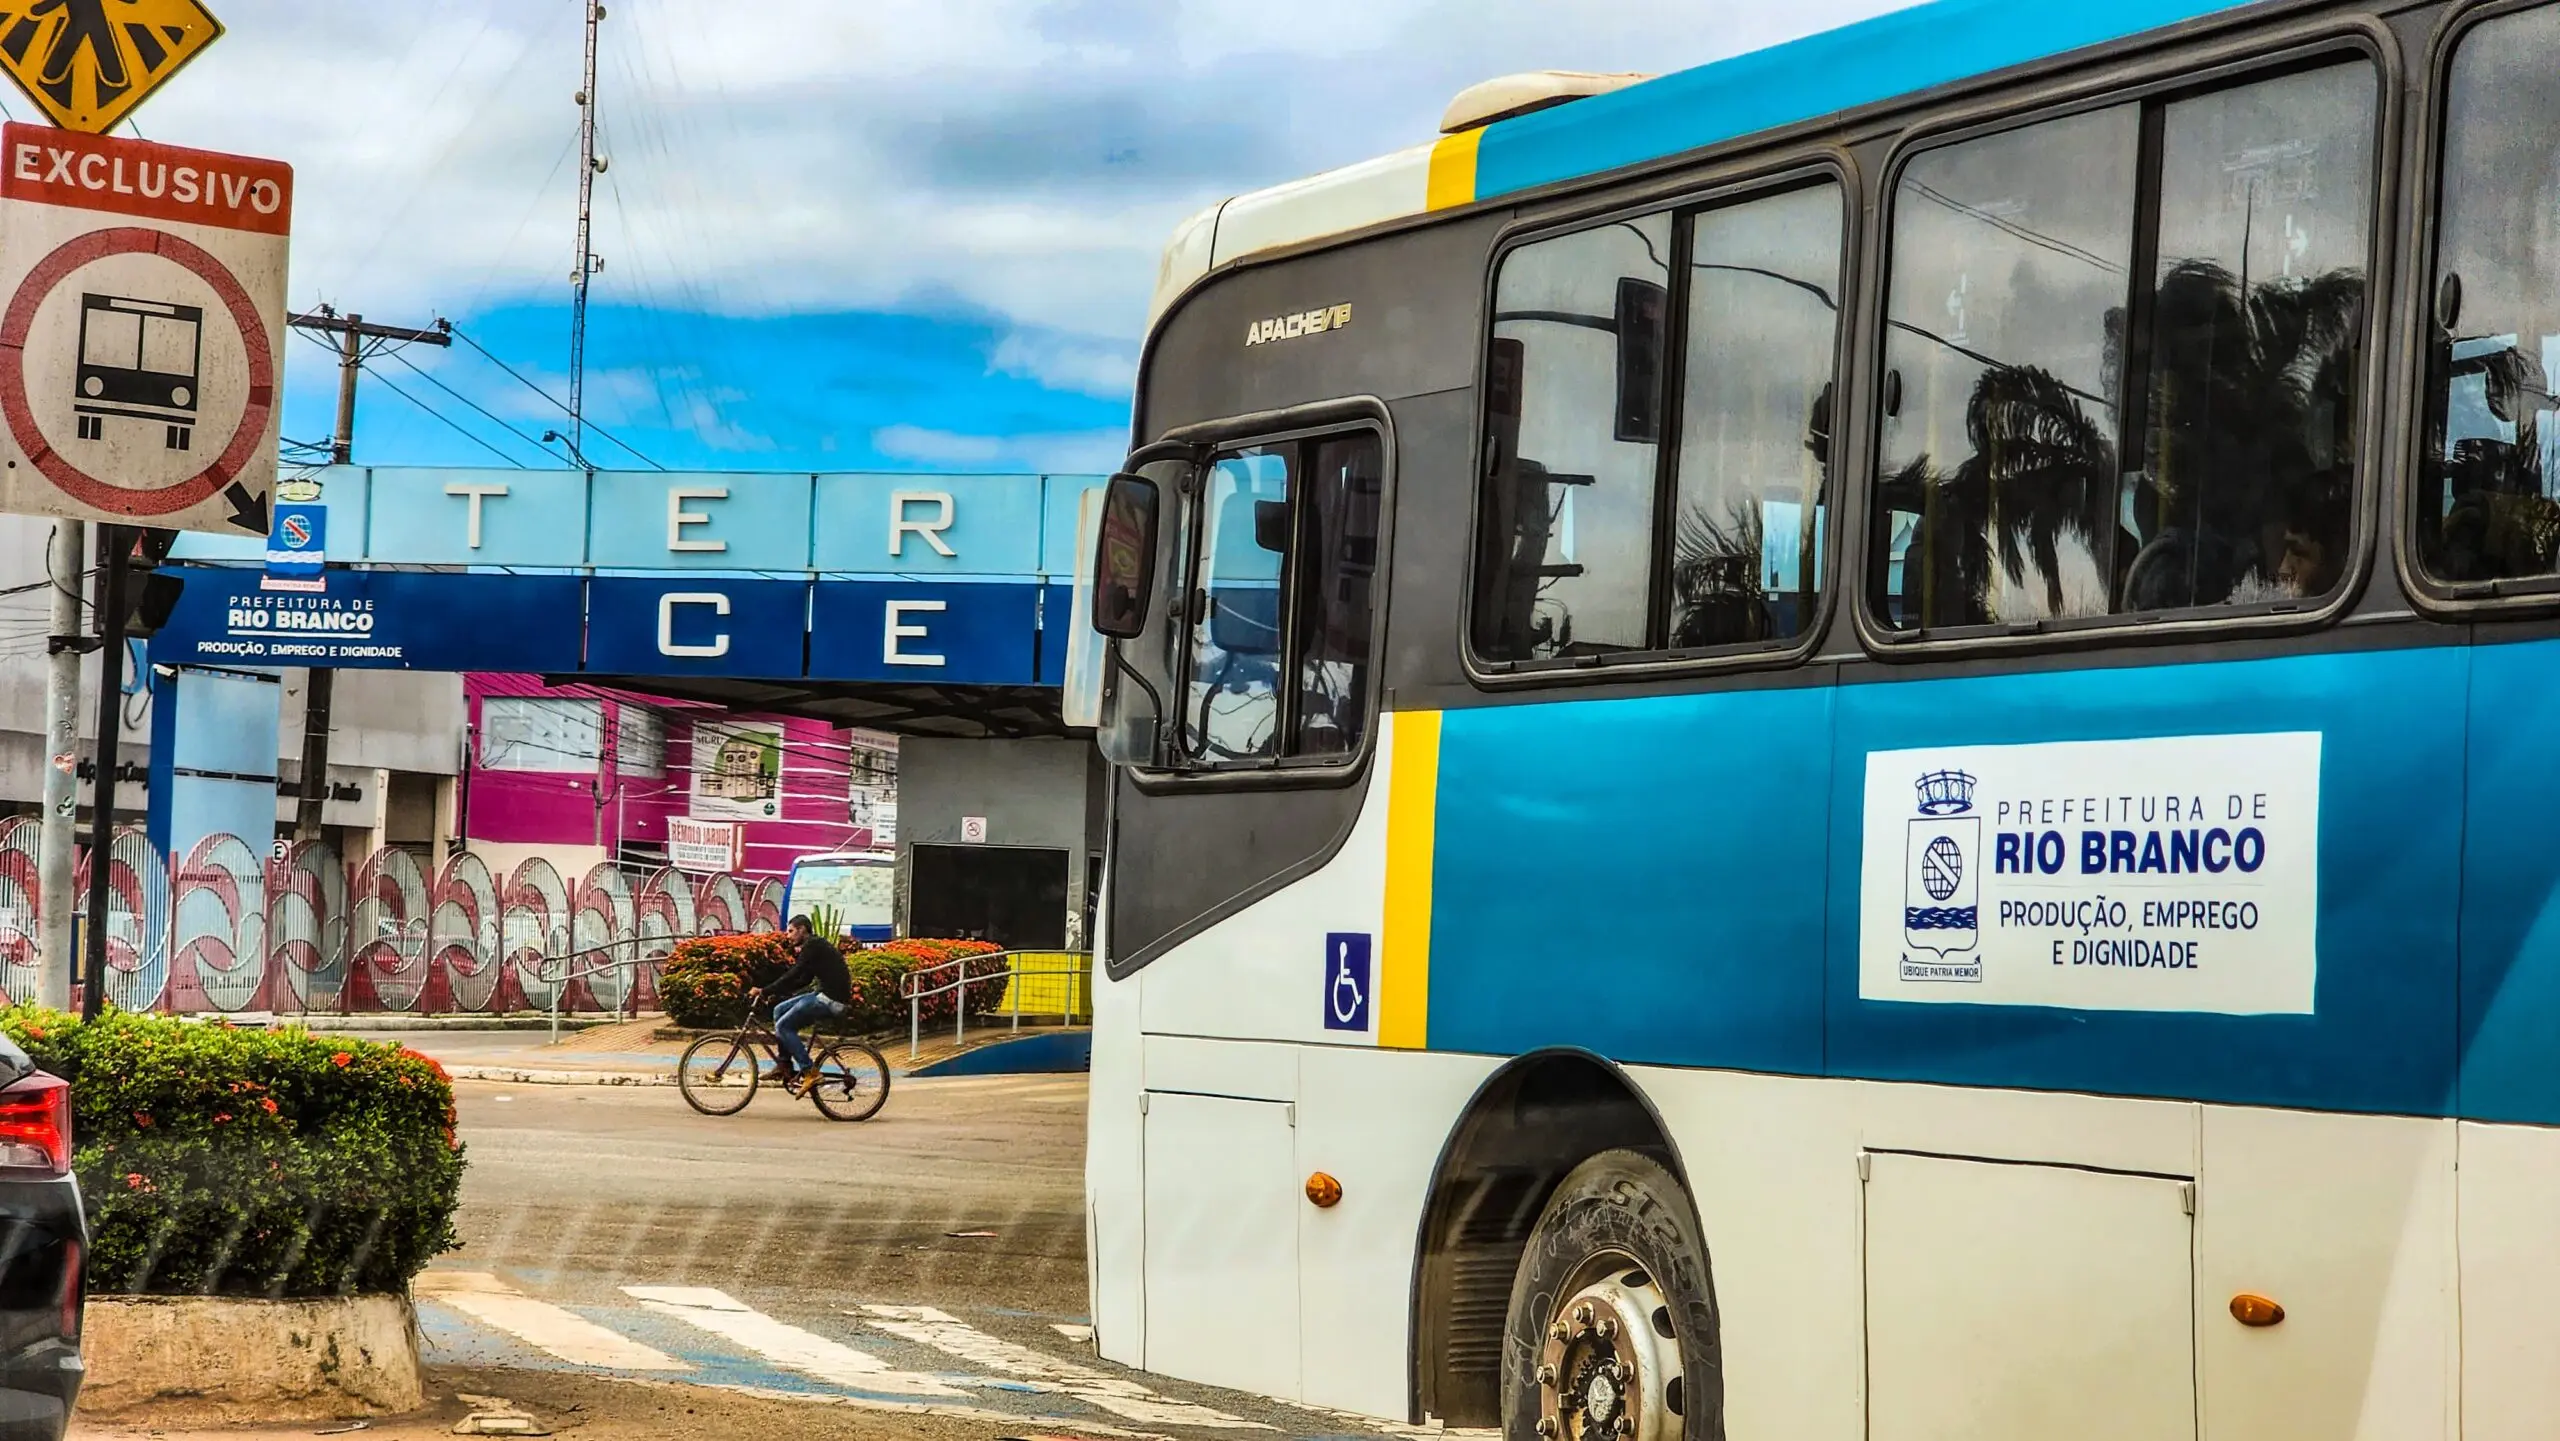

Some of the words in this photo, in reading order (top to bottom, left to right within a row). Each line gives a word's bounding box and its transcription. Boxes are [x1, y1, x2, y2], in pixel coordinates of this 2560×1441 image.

[14, 143, 281, 214] EXCLUSIVO
[229, 596, 342, 610] PREFEITURA
[352, 599, 374, 611] DE
[228, 609, 269, 628] RIO
[275, 611, 374, 632] BRANCO
[197, 641, 268, 656] PRODUÇÃO,
[270, 644, 327, 656] EMPREGO
[329, 646, 338, 657] E
[339, 646, 402, 658] DIGNIDADE
[1998, 795, 2204, 825] PREFEITURA
[2228, 793, 2268, 819] DE
[275, 845, 282, 860] E
[1995, 830, 2066, 874] RIO
[2080, 827, 2266, 875] BRANCO
[2000, 896, 2133, 935] PRODUÇÃO,
[2143, 901, 2259, 930] EMPREGO
[2052, 940, 2064, 966] E
[2072, 940, 2199, 969] DIGNIDADE
[1903, 965, 1929, 977] UBIQUE
[1930, 967, 1953, 977] PATRIA
[1954, 967, 1979, 978] MEMOR
